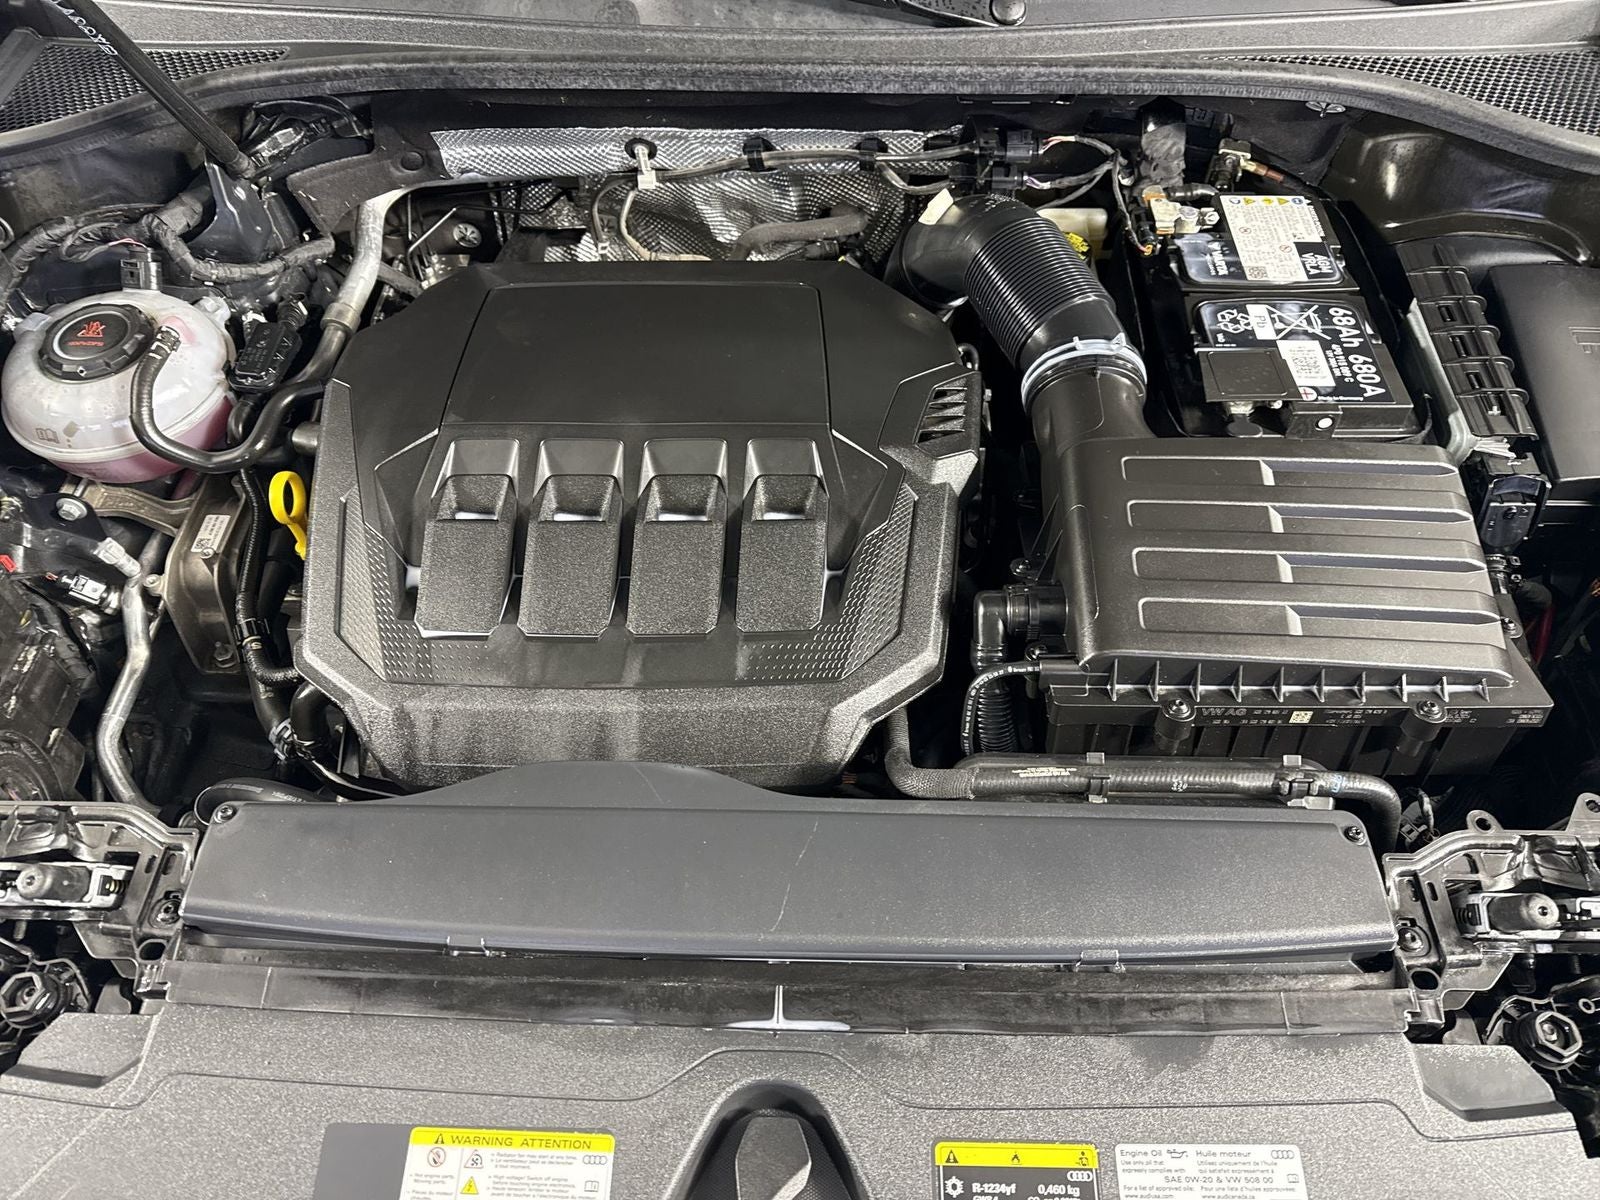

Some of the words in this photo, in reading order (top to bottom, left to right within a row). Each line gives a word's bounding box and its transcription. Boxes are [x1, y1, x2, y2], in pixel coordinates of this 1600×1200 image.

[1301, 252, 1320, 275] VRLA
[1313, 254, 1334, 273] AGM
[1254, 314, 1267, 329] Pb
[1328, 307, 1364, 348] 68Ah
[1347, 354, 1386, 397] 680A
[1201, 708, 1224, 716] VW
[1224, 708, 1247, 716] AG
[450, 1134, 513, 1147] WARNING
[520, 1138, 592, 1149] ATTENTION
[1119, 1149, 1148, 1158] Engine
[1150, 1149, 1162, 1157] Oil
[1164, 1175, 1182, 1183] SAE
[971, 1182, 1017, 1196] R-1234yf
[1037, 1184, 1066, 1195] 0,460
[1066, 1184, 1081, 1197] kg
